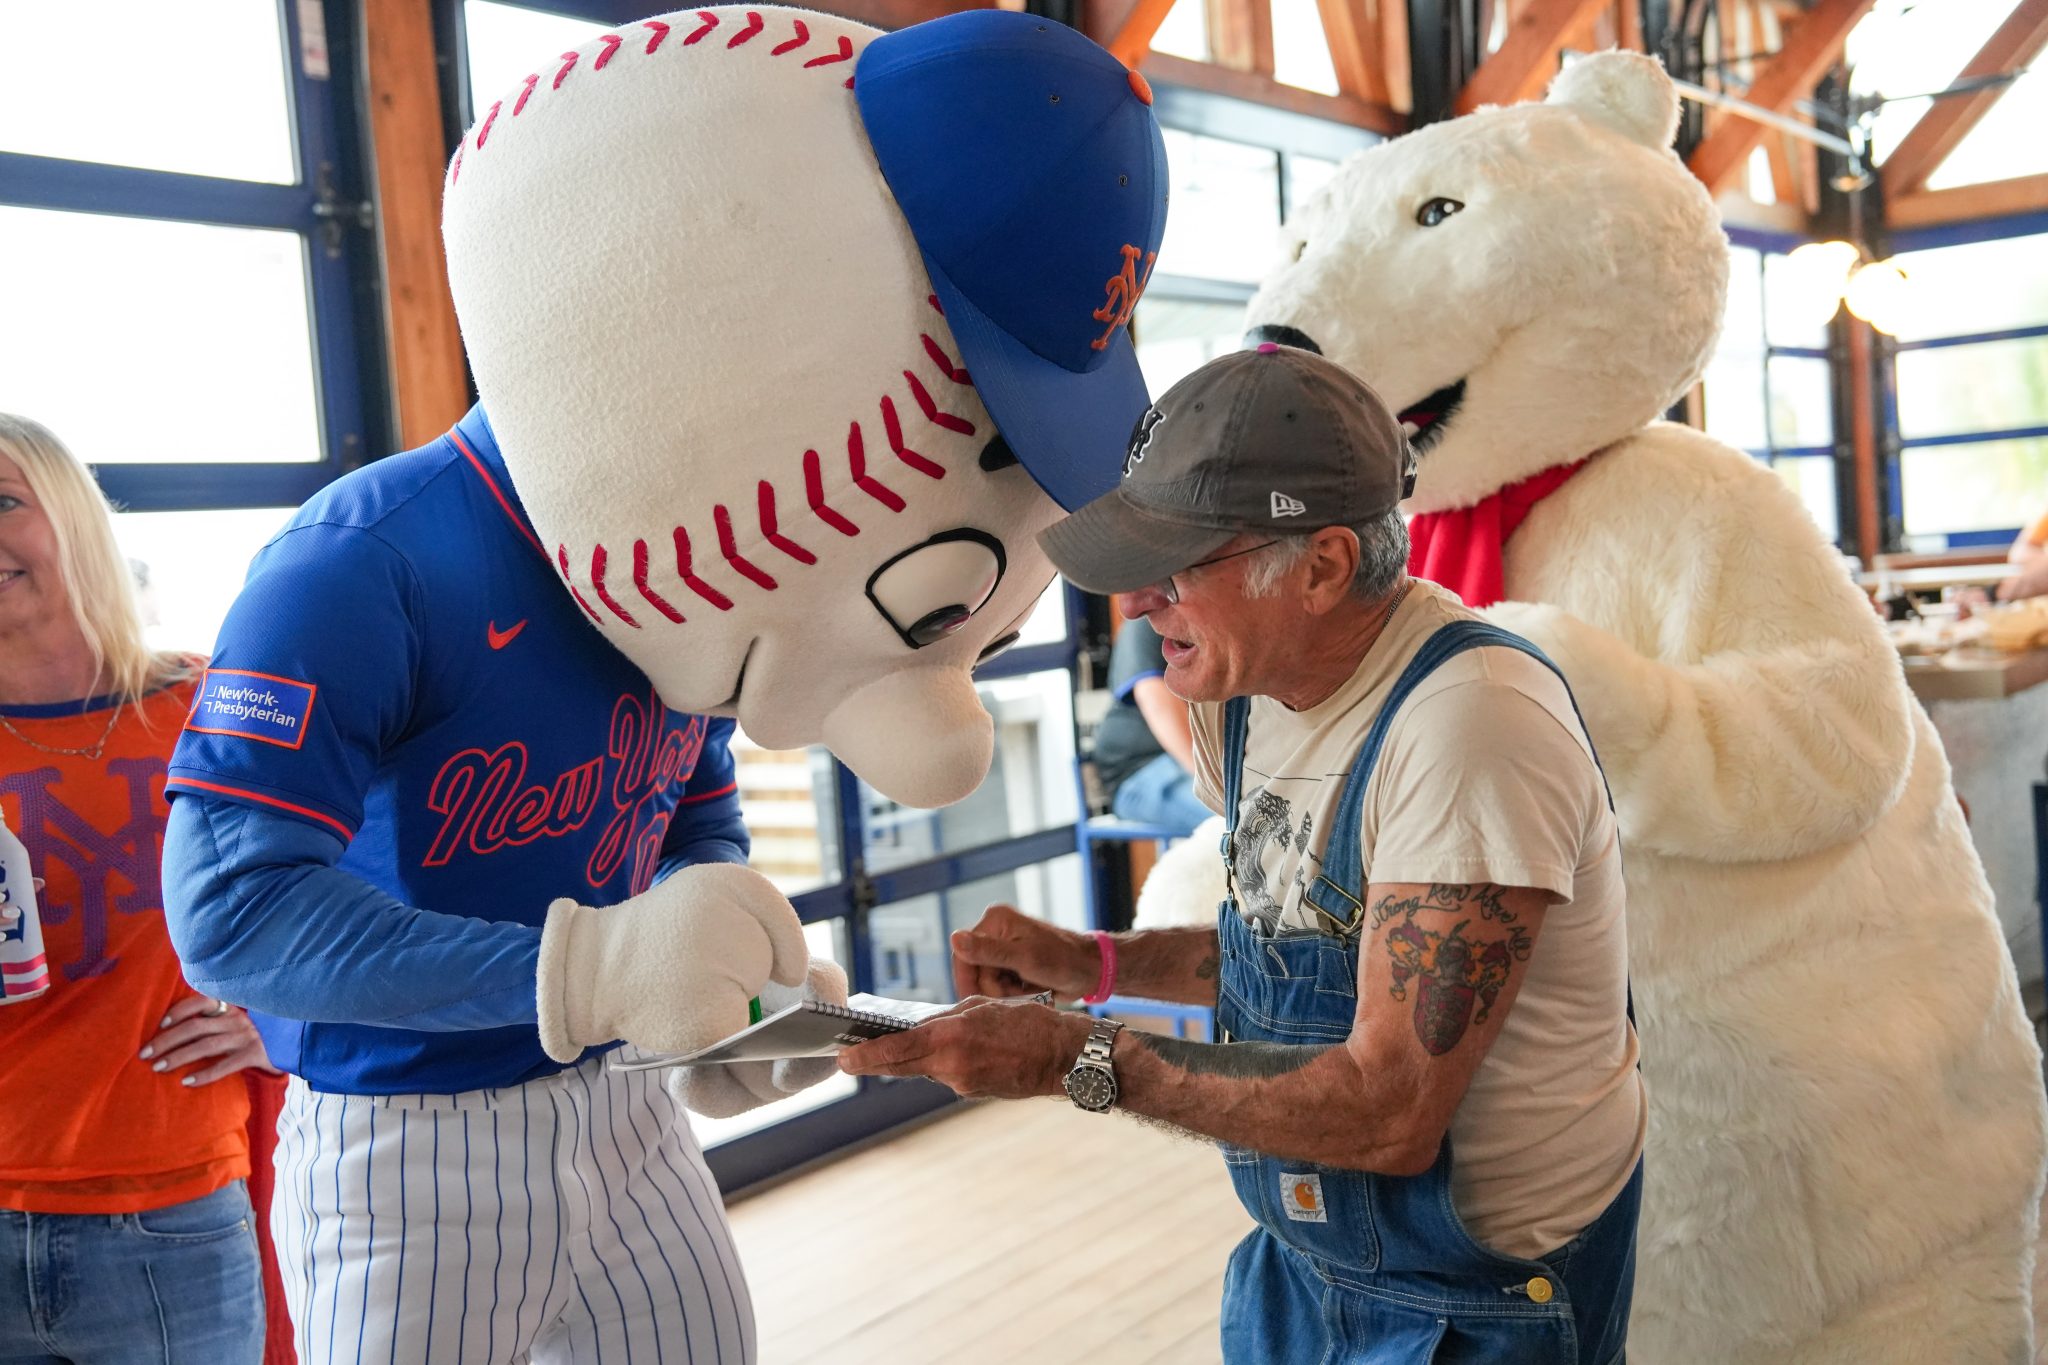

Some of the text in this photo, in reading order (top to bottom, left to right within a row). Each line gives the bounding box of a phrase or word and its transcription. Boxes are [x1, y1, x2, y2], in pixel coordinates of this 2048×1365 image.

[213, 700, 296, 728] Presbyterian
[422, 687, 710, 888] New Yor
